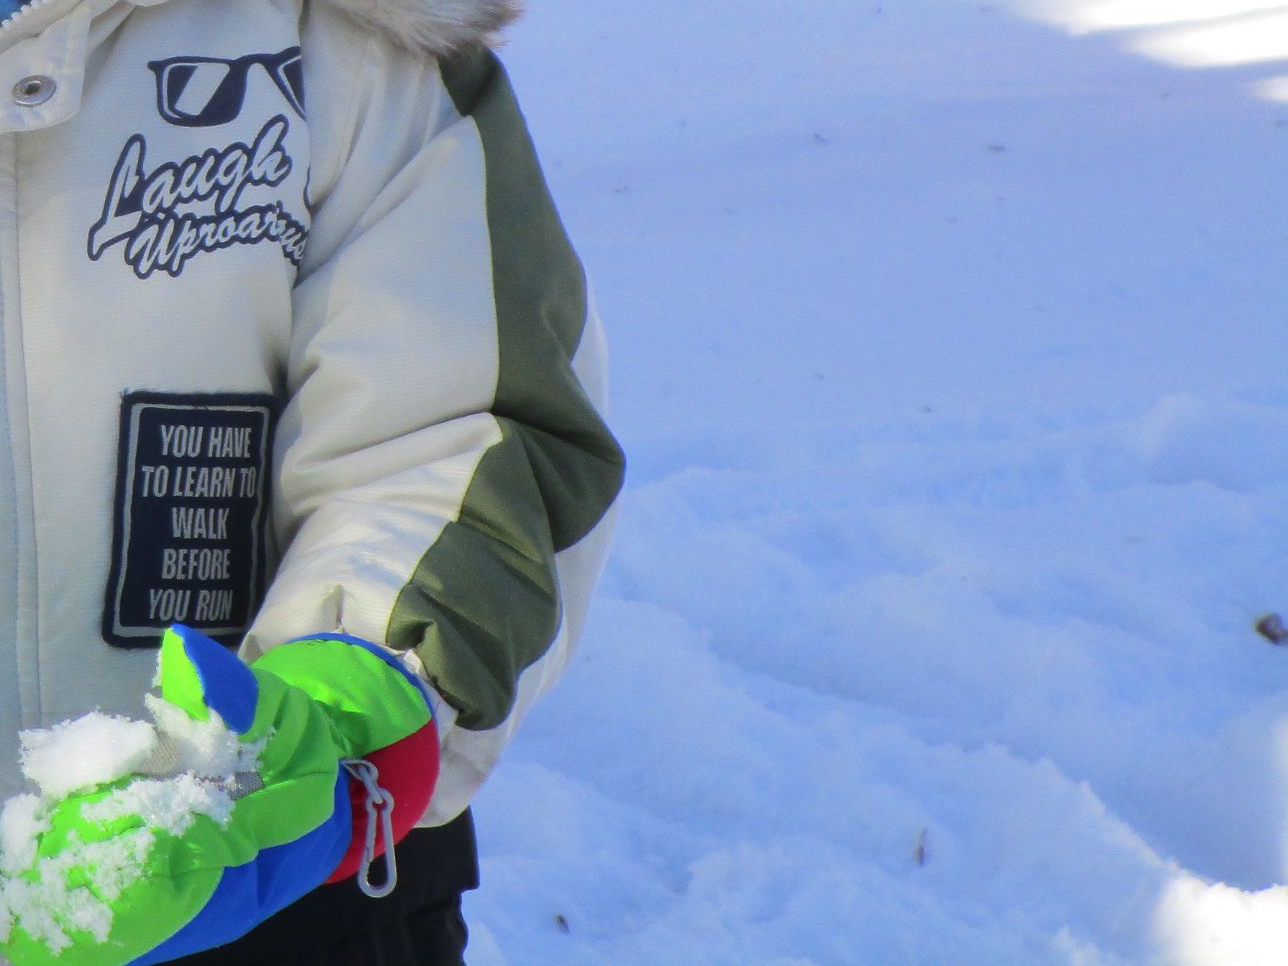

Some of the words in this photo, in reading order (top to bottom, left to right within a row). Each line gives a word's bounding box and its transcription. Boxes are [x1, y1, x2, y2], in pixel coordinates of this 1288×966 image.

[88, 114, 293, 261] Laugh
[160, 424, 203, 458] YOU
[207, 426, 253, 458] HAVE
[141, 465, 169, 498] TO
[172, 466, 236, 498] LEARN
[239, 466, 257, 498] TO
[171, 507, 230, 539] WALK
[161, 548, 231, 580] BEFORE
[148, 588, 191, 622] YOU
[194, 589, 234, 622] RUN
